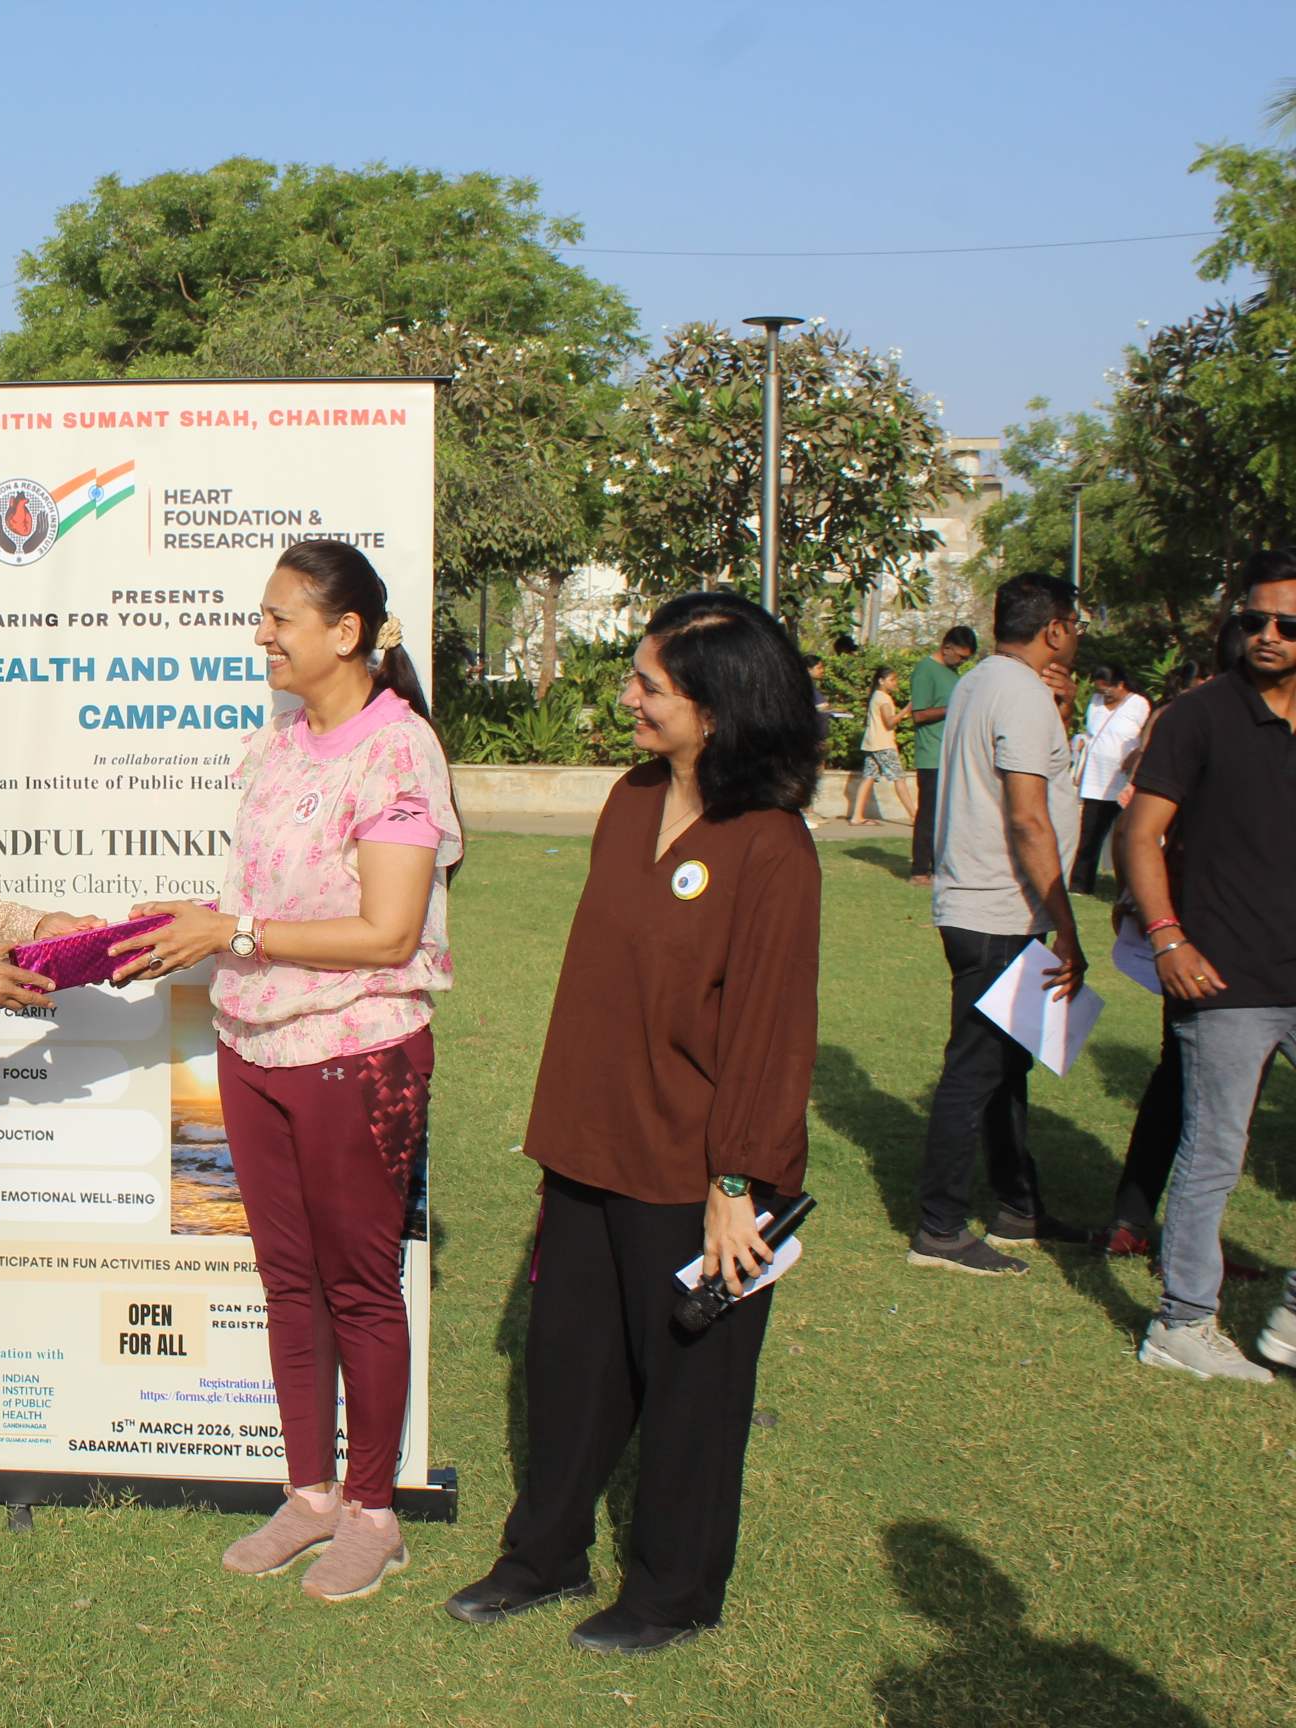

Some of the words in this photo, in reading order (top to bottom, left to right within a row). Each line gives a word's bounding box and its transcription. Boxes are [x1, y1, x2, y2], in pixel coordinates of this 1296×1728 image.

[63, 411, 169, 429] SUMANT
[180, 410, 258, 431] SHAH,
[269, 409, 407, 427] CHAIRMAN
[21, 482, 54, 513] RESEARCH
[164, 489, 233, 504] HEART
[164, 510, 302, 526] FOUNDATION
[308, 510, 322, 525] &
[164, 533, 274, 549] RESEARCH
[112, 590, 224, 604] PRESENTS
[68, 612, 109, 627] FOR
[118, 611, 171, 630] YOU,
[179, 612, 262, 627] CARING
[106, 657, 180, 682] AND
[78, 704, 264, 730] CAMPAIGN
[93, 754, 107, 766] In
[112, 753, 199, 766] collaboration
[203, 753, 231, 766] with
[25, 775, 99, 790] Institute
[105, 775, 123, 790] of
[129, 774, 184, 790] Public
[191, 775, 243, 790] Healt
[72, 873, 148, 898] Clarity,
[3, 1068, 48, 1080] FOCUS
[1, 1191, 76, 1204] EMOTIONAL
[80, 1191, 156, 1206] WELL-BEING
[57, 1256, 70, 1269] IN
[73, 1256, 97, 1270] FUN
[100, 1257, 171, 1271] ACTIVITIES
[174, 1259, 202, 1272] AND
[205, 1260, 230, 1272] WIN
[128, 1304, 173, 1327] OPEN
[209, 1303, 242, 1313] SCAN
[119, 1333, 153, 1356] FOR
[157, 1334, 188, 1357] ALL
[36, 1348, 65, 1360] with
[2, 1373, 40, 1384] INDIAN
[199, 1377, 260, 1390] Registration
[2, 1385, 55, 1396] INSTITUTE
[2, 1398, 13, 1408] of
[15, 1398, 52, 1409] PUBLIC
[2, 1410, 42, 1420] HEALTH
[139, 1421, 193, 1436] MARCH
[197, 1423, 235, 1438] 2026,
[68, 1438, 152, 1454] SABARMATI
[156, 1440, 242, 1457] RIVERFRONT
